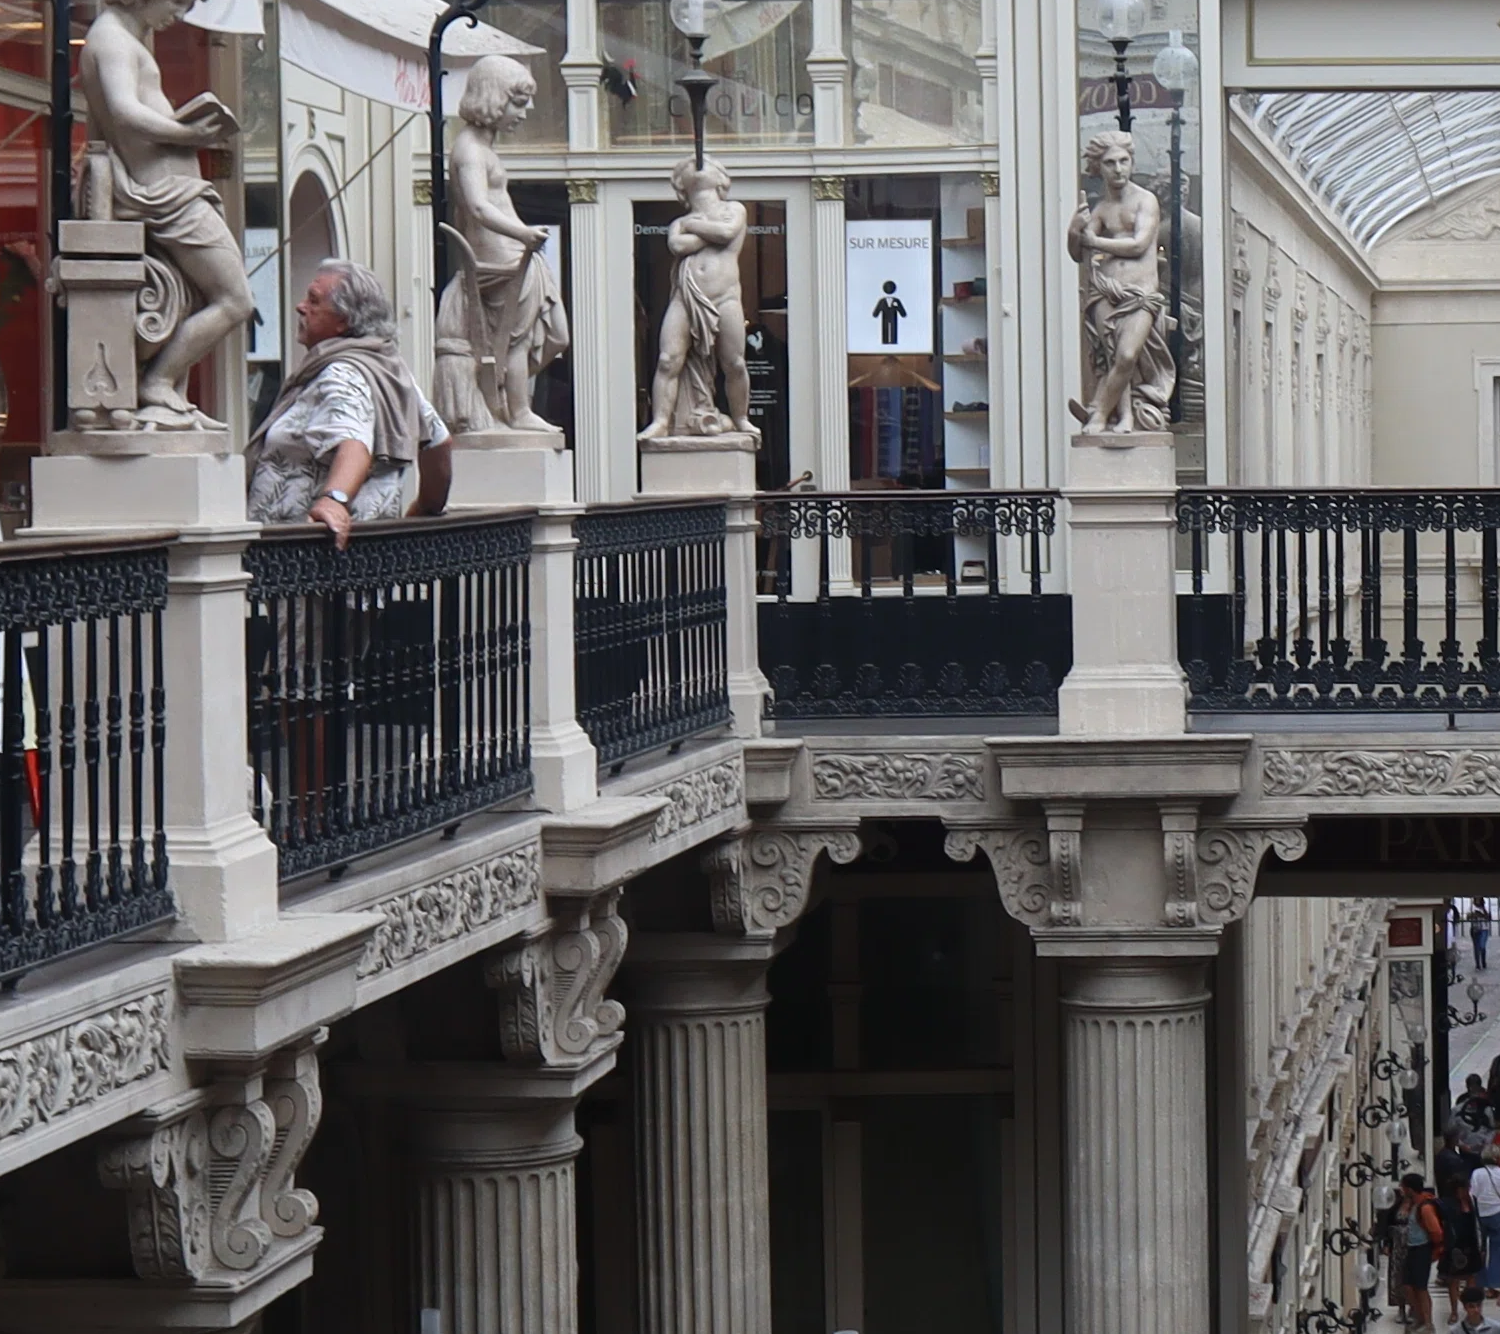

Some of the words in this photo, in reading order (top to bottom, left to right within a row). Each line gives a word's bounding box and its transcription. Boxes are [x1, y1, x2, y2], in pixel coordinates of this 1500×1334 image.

[668, 93, 814, 121] CQLICO
[849, 237, 875, 250] SUR
[877, 237, 930, 250] MESURE
